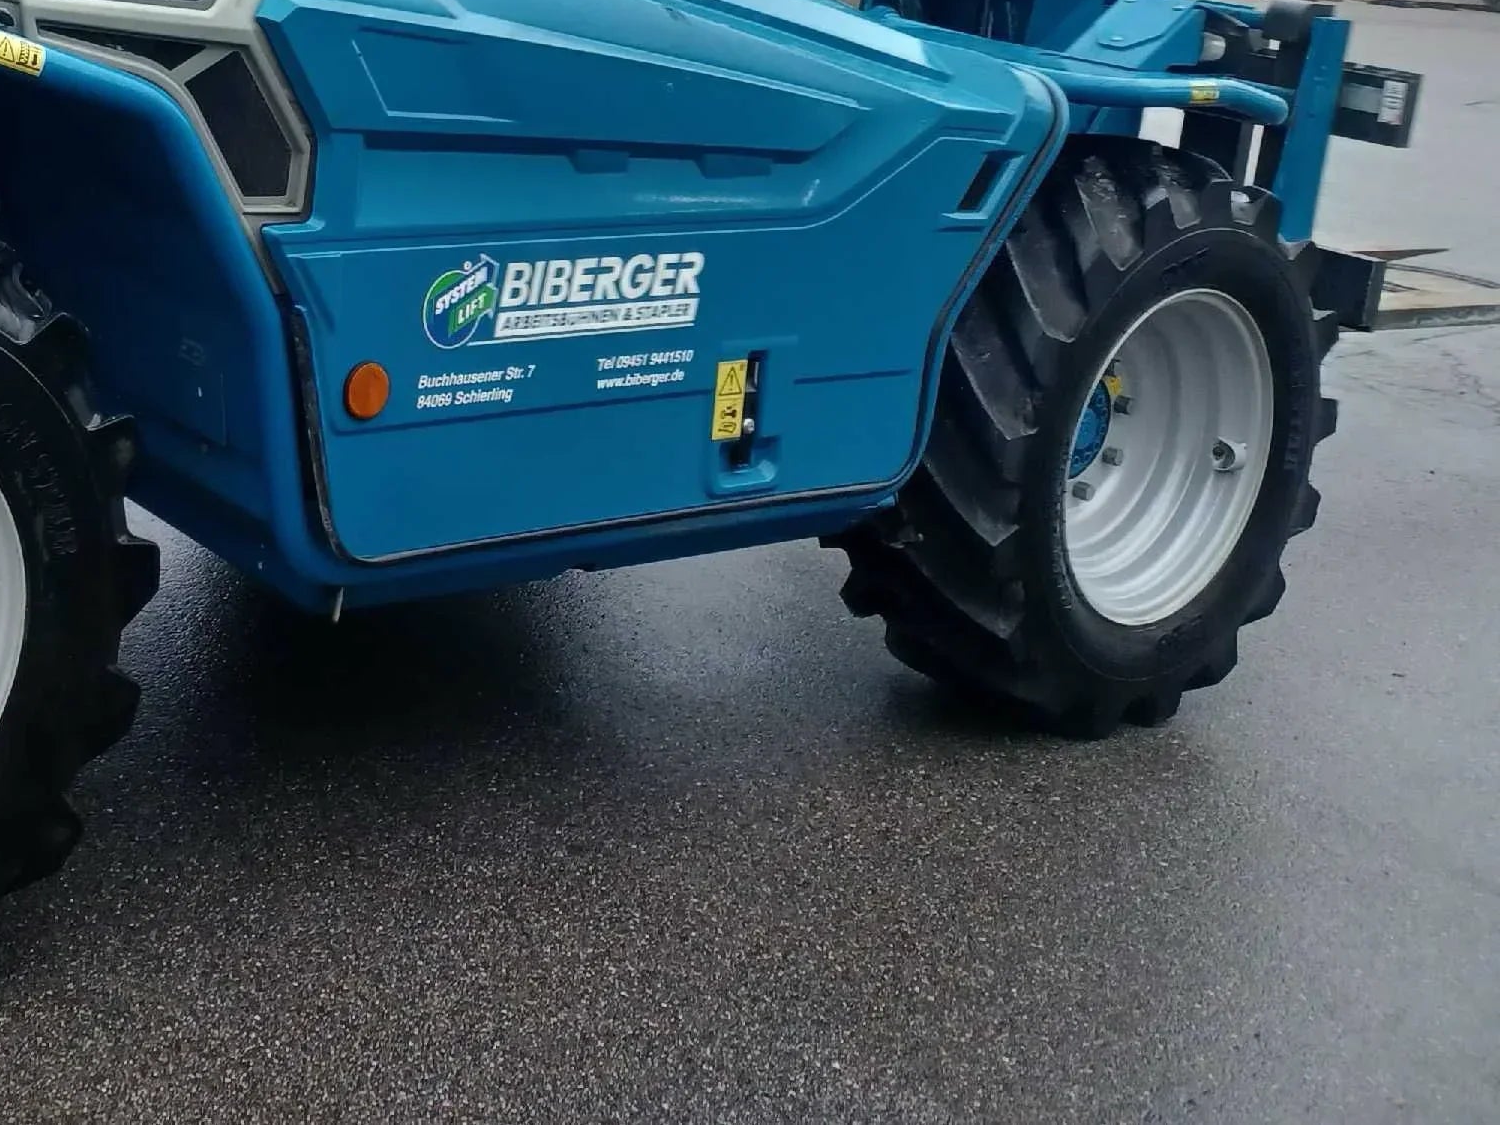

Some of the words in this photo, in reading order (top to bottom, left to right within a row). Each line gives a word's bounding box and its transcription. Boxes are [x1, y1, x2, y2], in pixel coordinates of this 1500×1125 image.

[500, 252, 705, 308] BIBERGER
[457, 292, 487, 325] LIFT
[597, 357, 616, 371] Tel
[615, 354, 649, 368] 09451
[418, 371, 504, 389] Buchhausener
[505, 367, 525, 380] Str.
[527, 365, 536, 378] 7
[597, 369, 685, 389] www.biberger.de
[416, 392, 453, 409] 84069
[454, 387, 514, 405] Schierling
